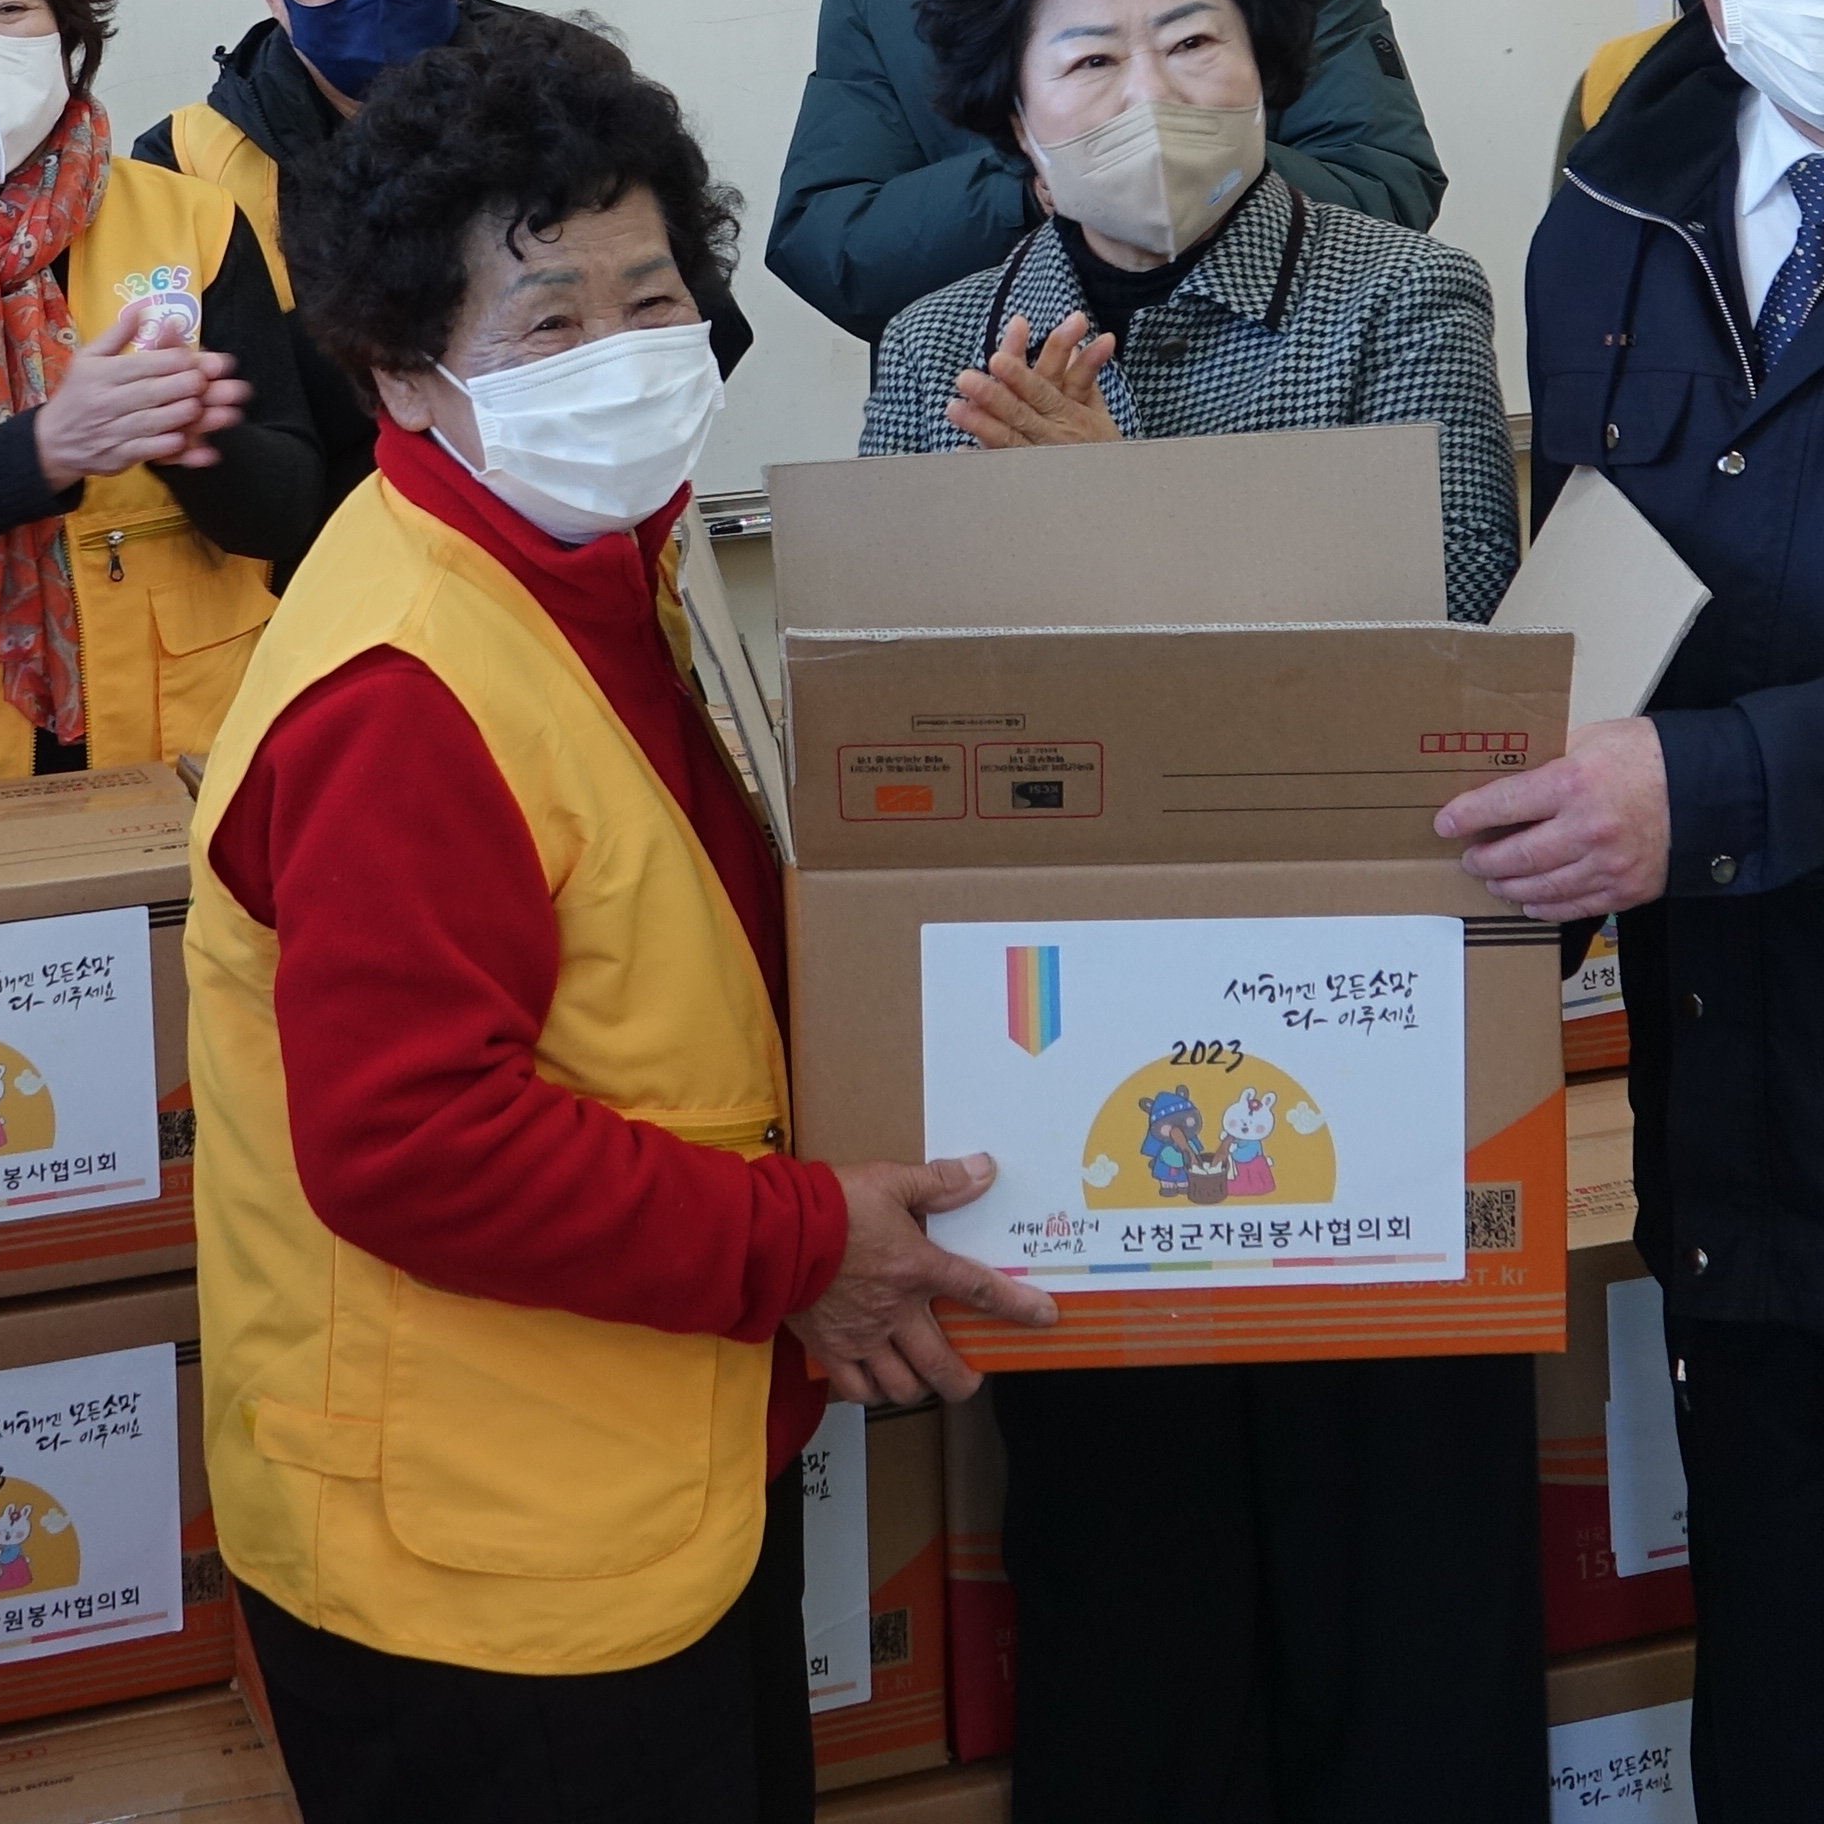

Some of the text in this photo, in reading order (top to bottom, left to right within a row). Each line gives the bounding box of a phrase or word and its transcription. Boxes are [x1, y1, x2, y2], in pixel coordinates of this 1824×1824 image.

[113, 264, 192, 299] 1365
[1224, 969, 1418, 1005] 새해엔 모든소망
[1170, 1039, 1245, 1073] 2023
[1120, 1215, 1413, 1254] 산청군자원봉사협의회
